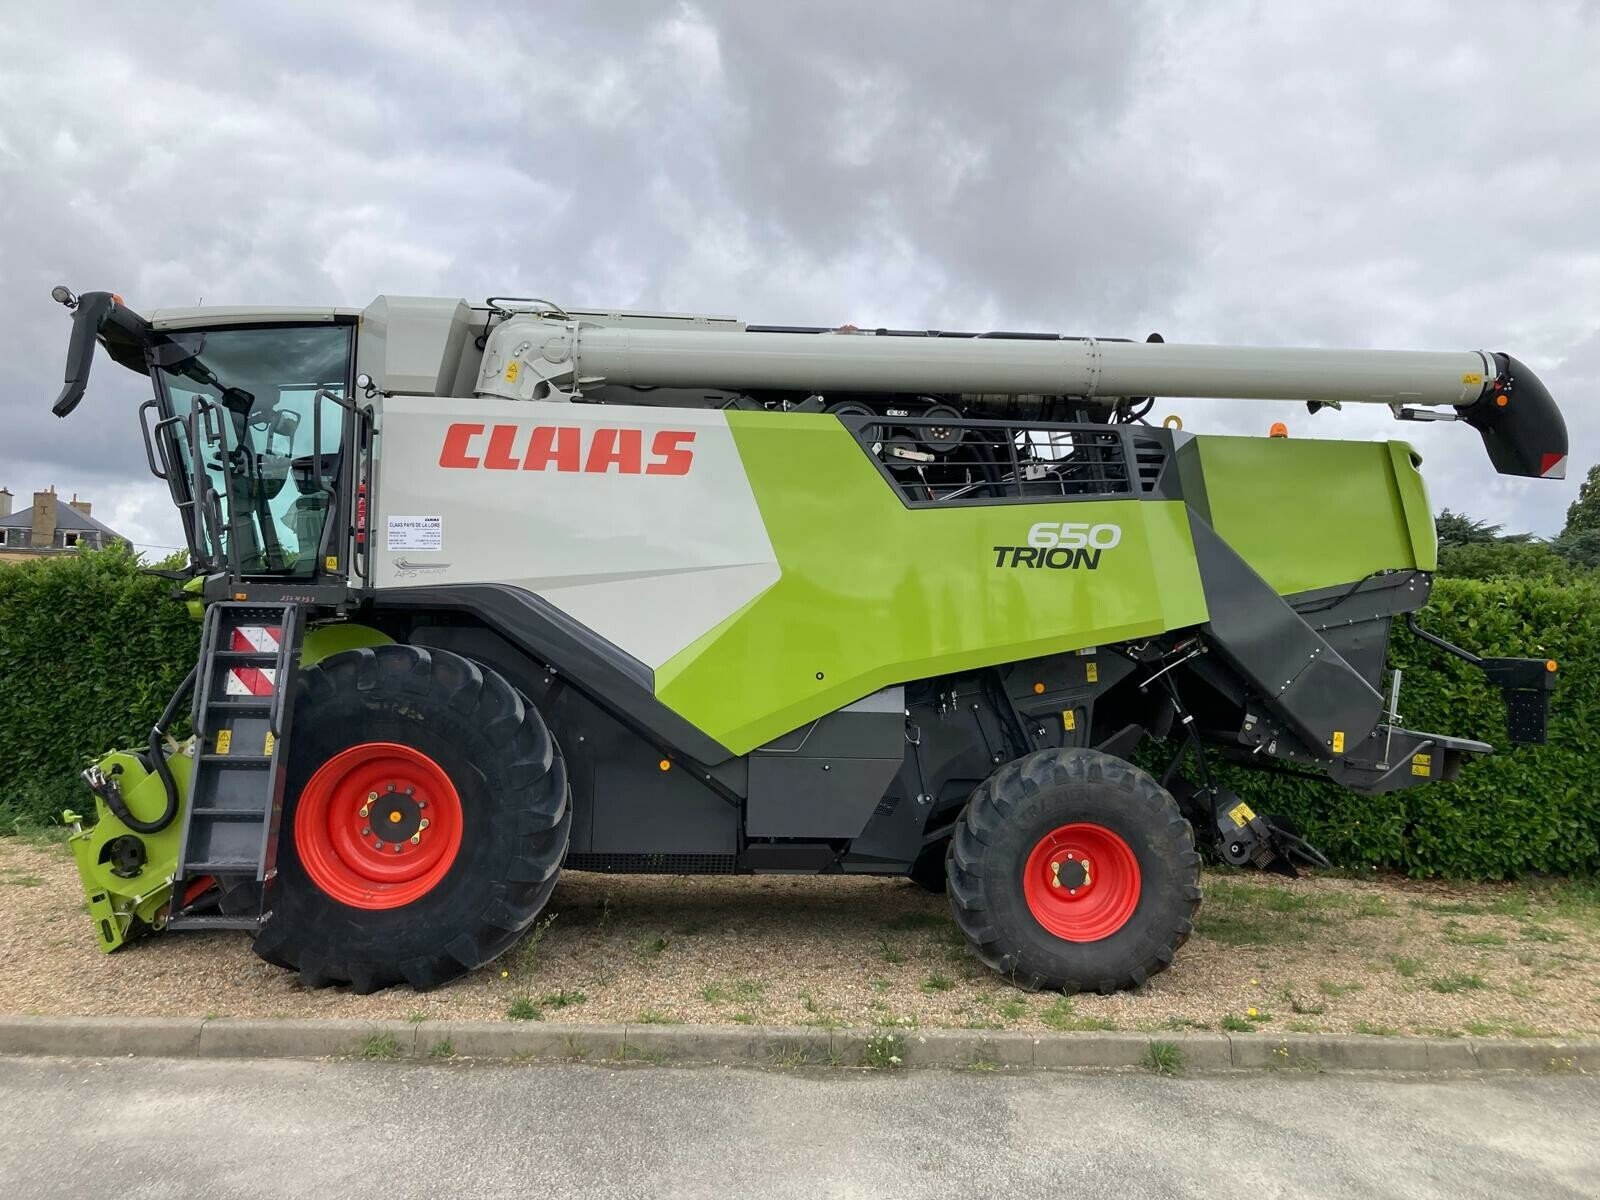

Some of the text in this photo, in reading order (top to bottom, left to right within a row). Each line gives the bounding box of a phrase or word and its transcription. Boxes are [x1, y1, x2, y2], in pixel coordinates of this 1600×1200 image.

[438, 423, 697, 476] CLAAS
[1027, 522, 1122, 550] 650
[993, 546, 1102, 570] TRION
